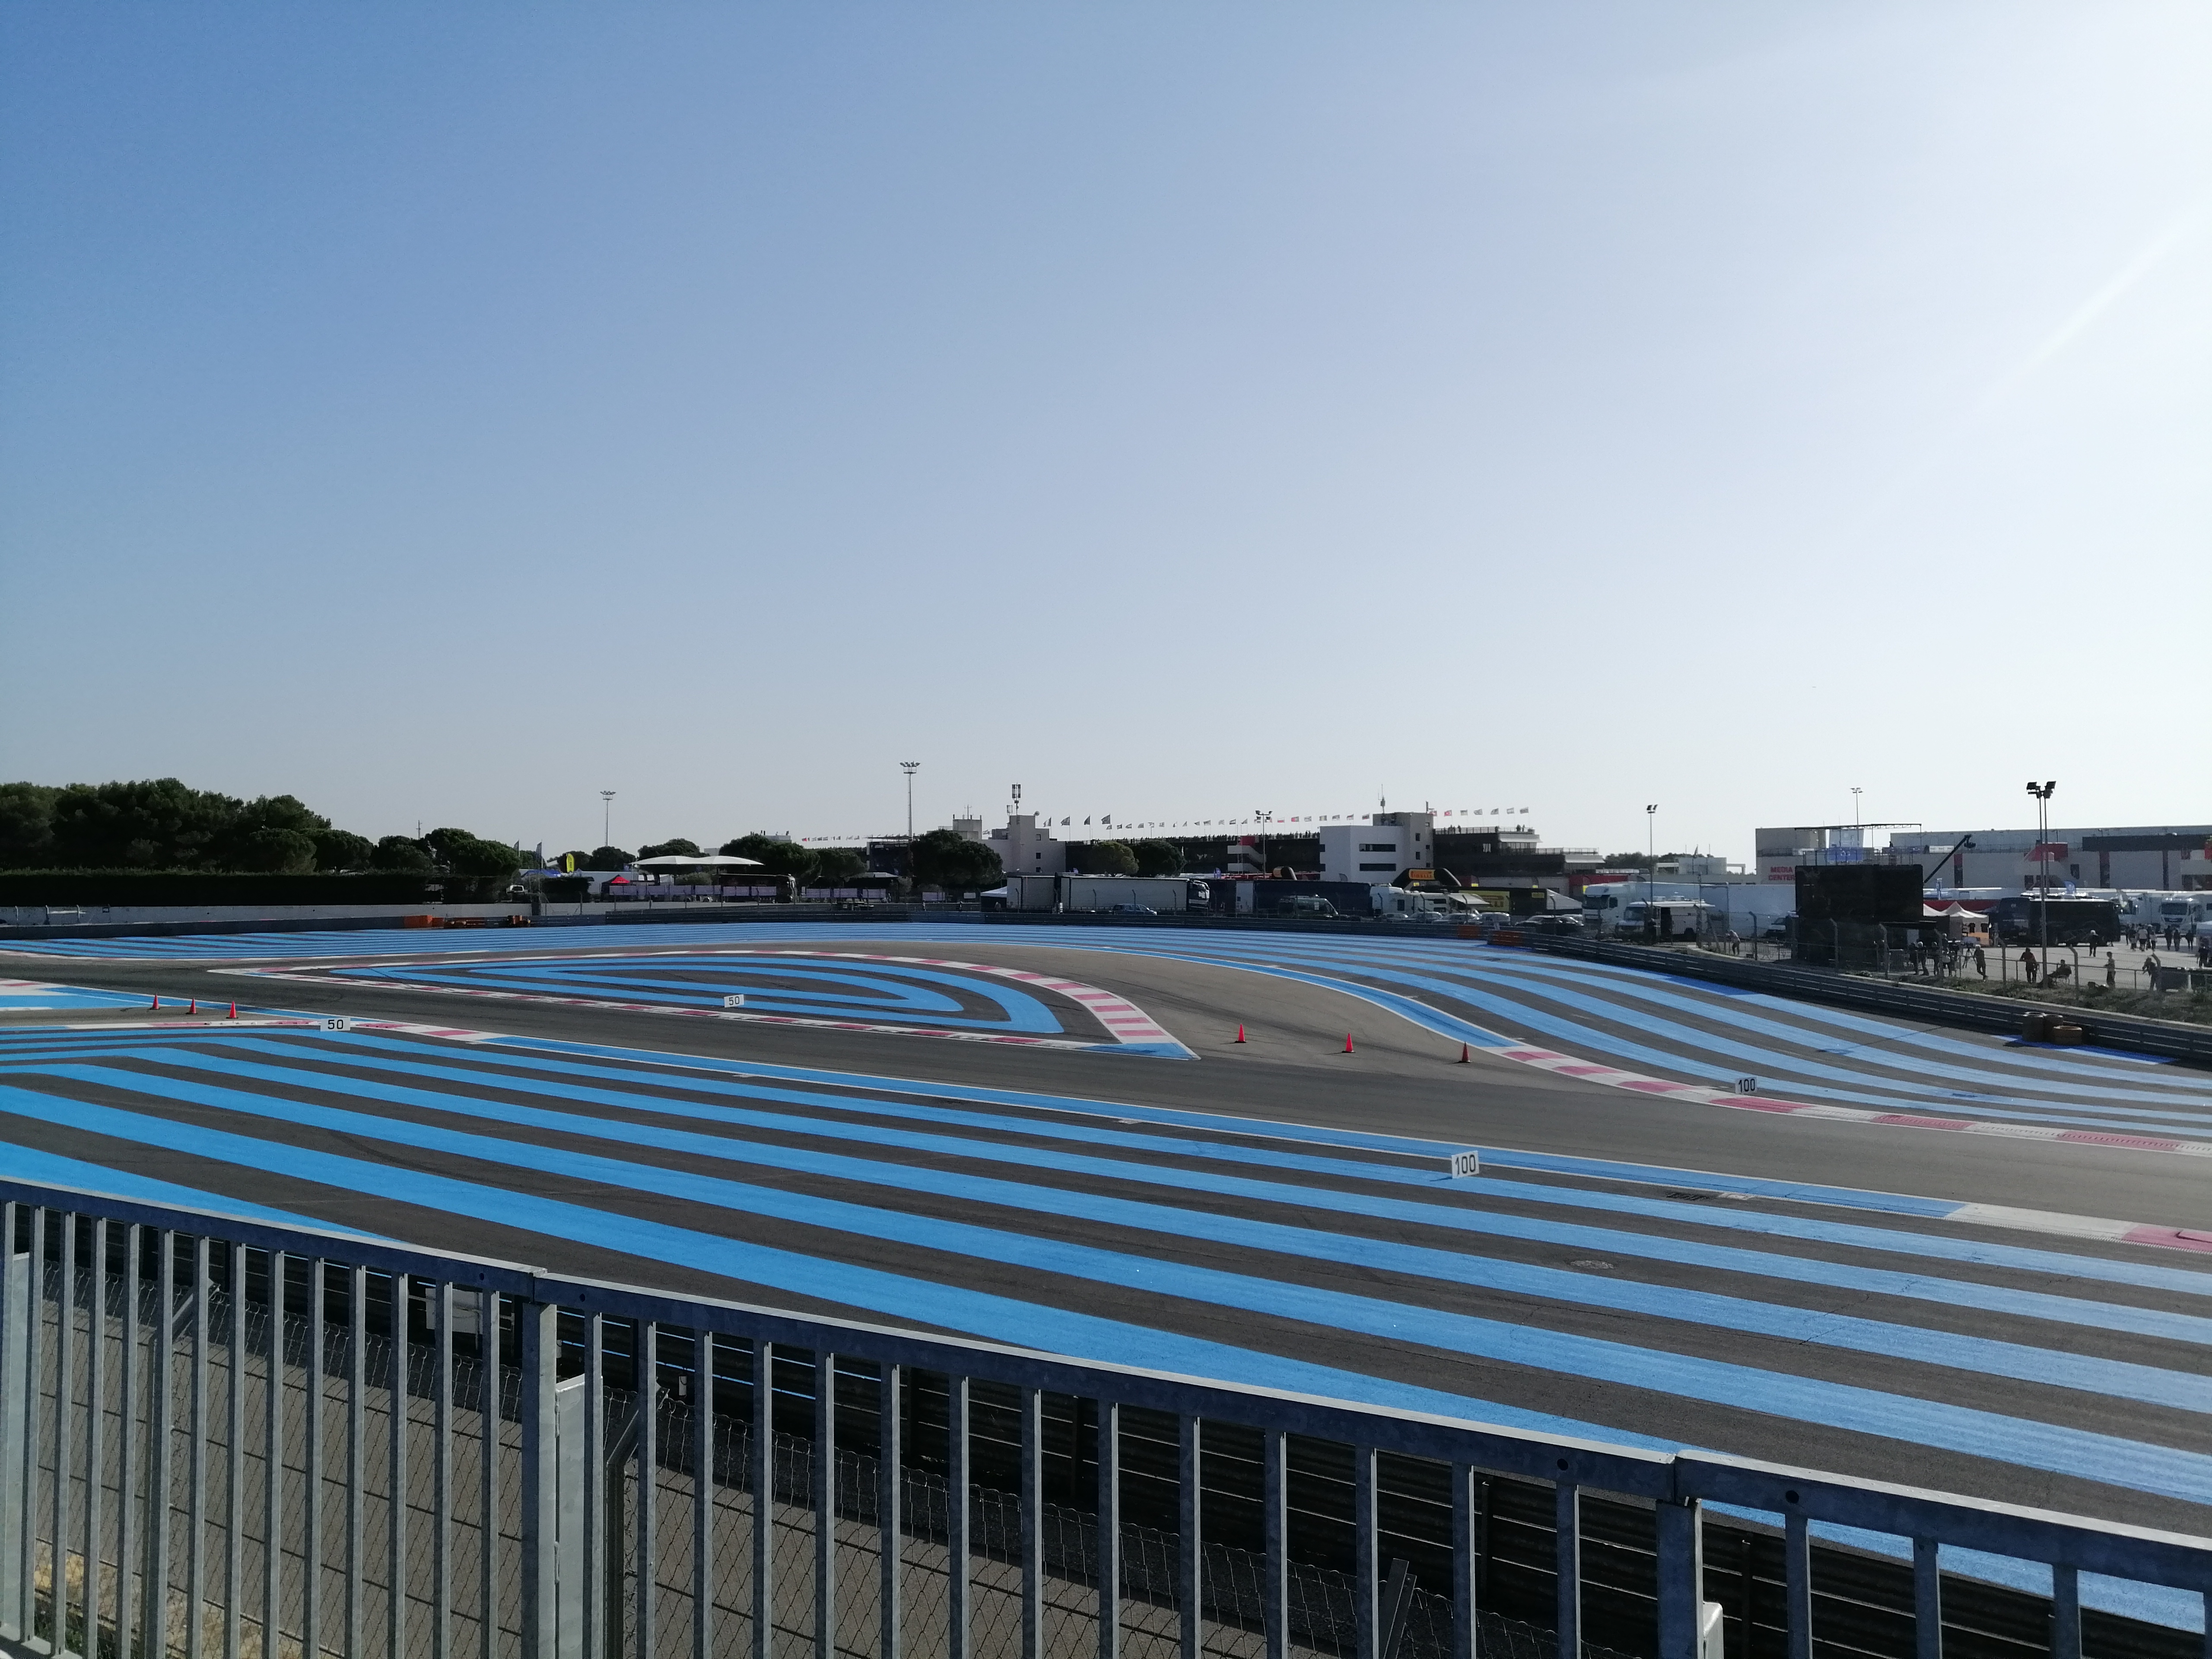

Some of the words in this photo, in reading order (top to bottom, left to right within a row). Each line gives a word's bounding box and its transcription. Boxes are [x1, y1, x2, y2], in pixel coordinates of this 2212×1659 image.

[729, 996, 740, 1006] 50
[327, 1019, 343, 1030] 50
[1738, 1078, 1755, 1093] 100
[1455, 1154, 1476, 1175] 100
